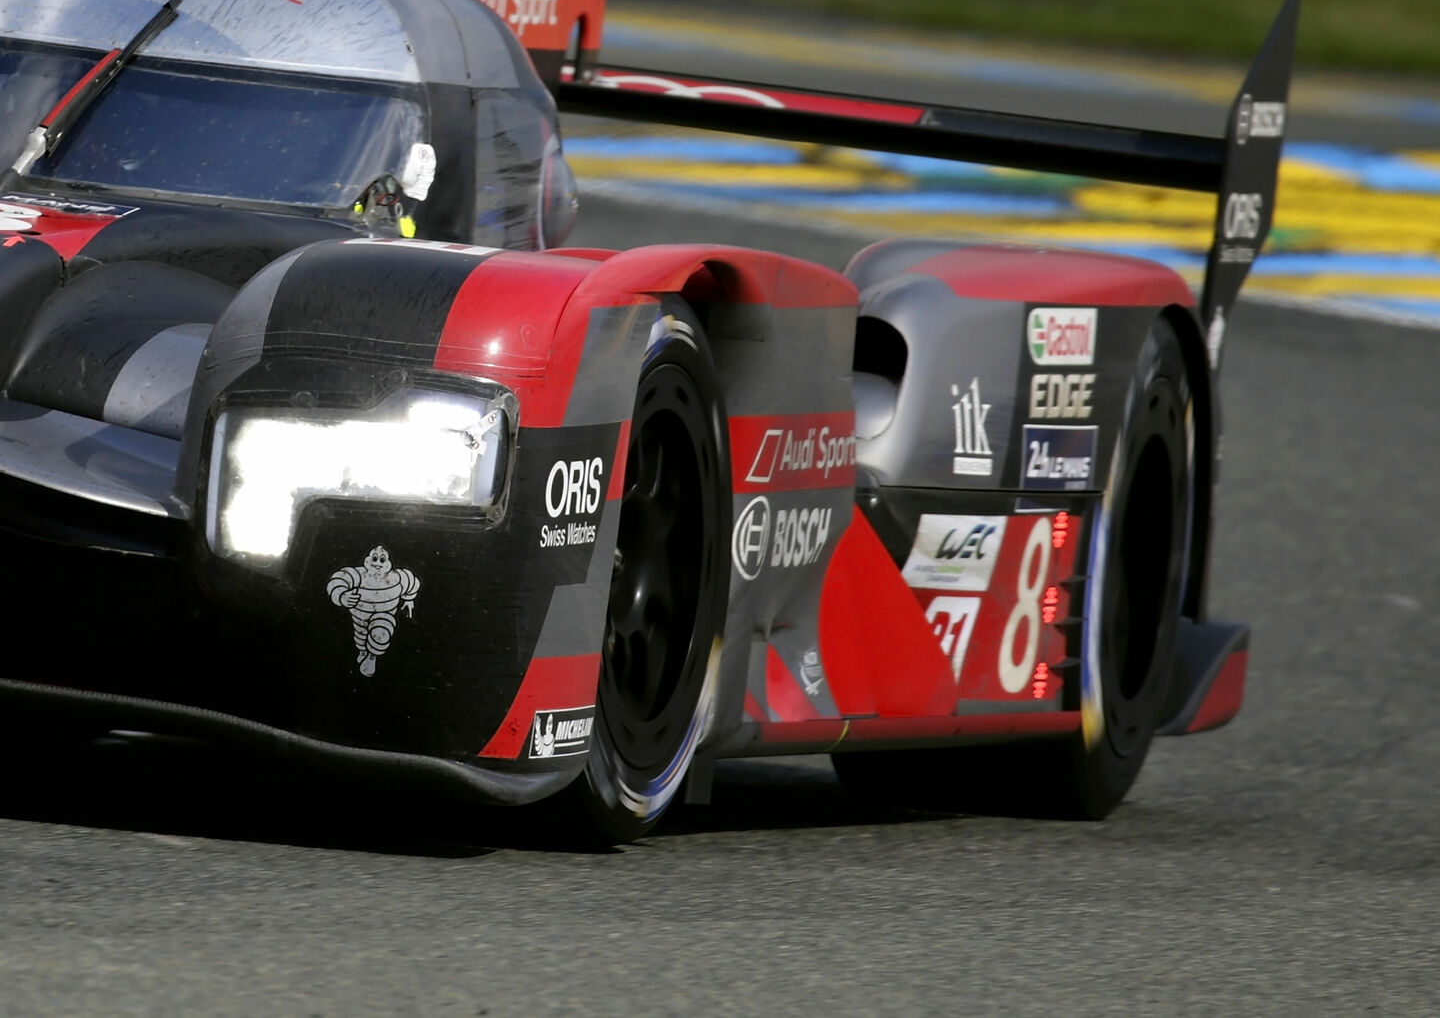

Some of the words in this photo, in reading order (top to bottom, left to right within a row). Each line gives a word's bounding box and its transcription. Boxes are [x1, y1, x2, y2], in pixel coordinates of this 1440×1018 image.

[951, 376, 993, 455] itk
[1029, 373, 1097, 419] EDGE
[779, 428, 816, 471] Audi
[816, 426, 856, 479] Sport
[545, 456, 604, 518] ORIS
[540, 524, 566, 548] Swiss
[567, 521, 597, 545] Watches
[770, 508, 832, 568] BOSCH
[936, 523, 997, 560] WEC
[998, 517, 1052, 693] 8
[555, 716, 595, 741] MICHELIN
